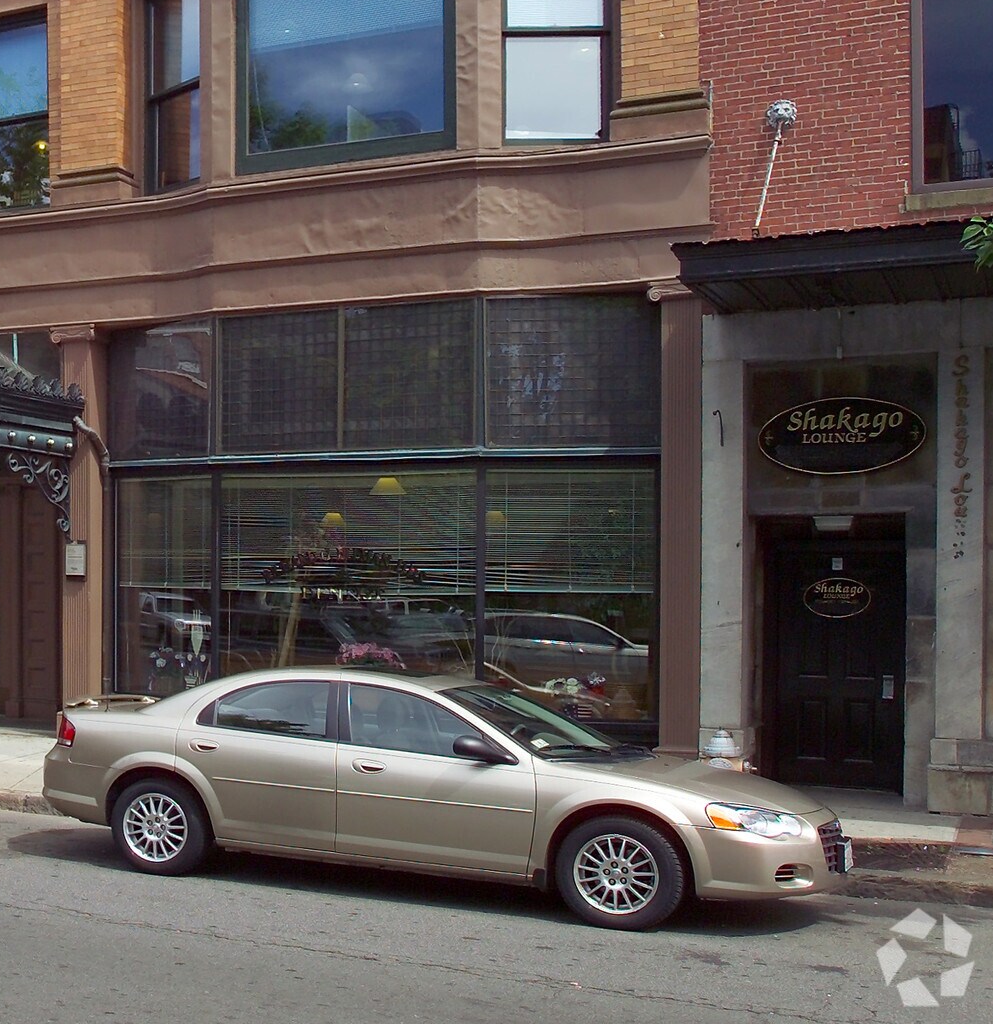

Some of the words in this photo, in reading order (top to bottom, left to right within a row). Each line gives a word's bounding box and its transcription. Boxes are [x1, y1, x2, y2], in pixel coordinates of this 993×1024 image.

[786, 406, 904, 438] Shakago
[801, 431, 867, 444] LOUNGE
[814, 582, 864, 597] Shakago
